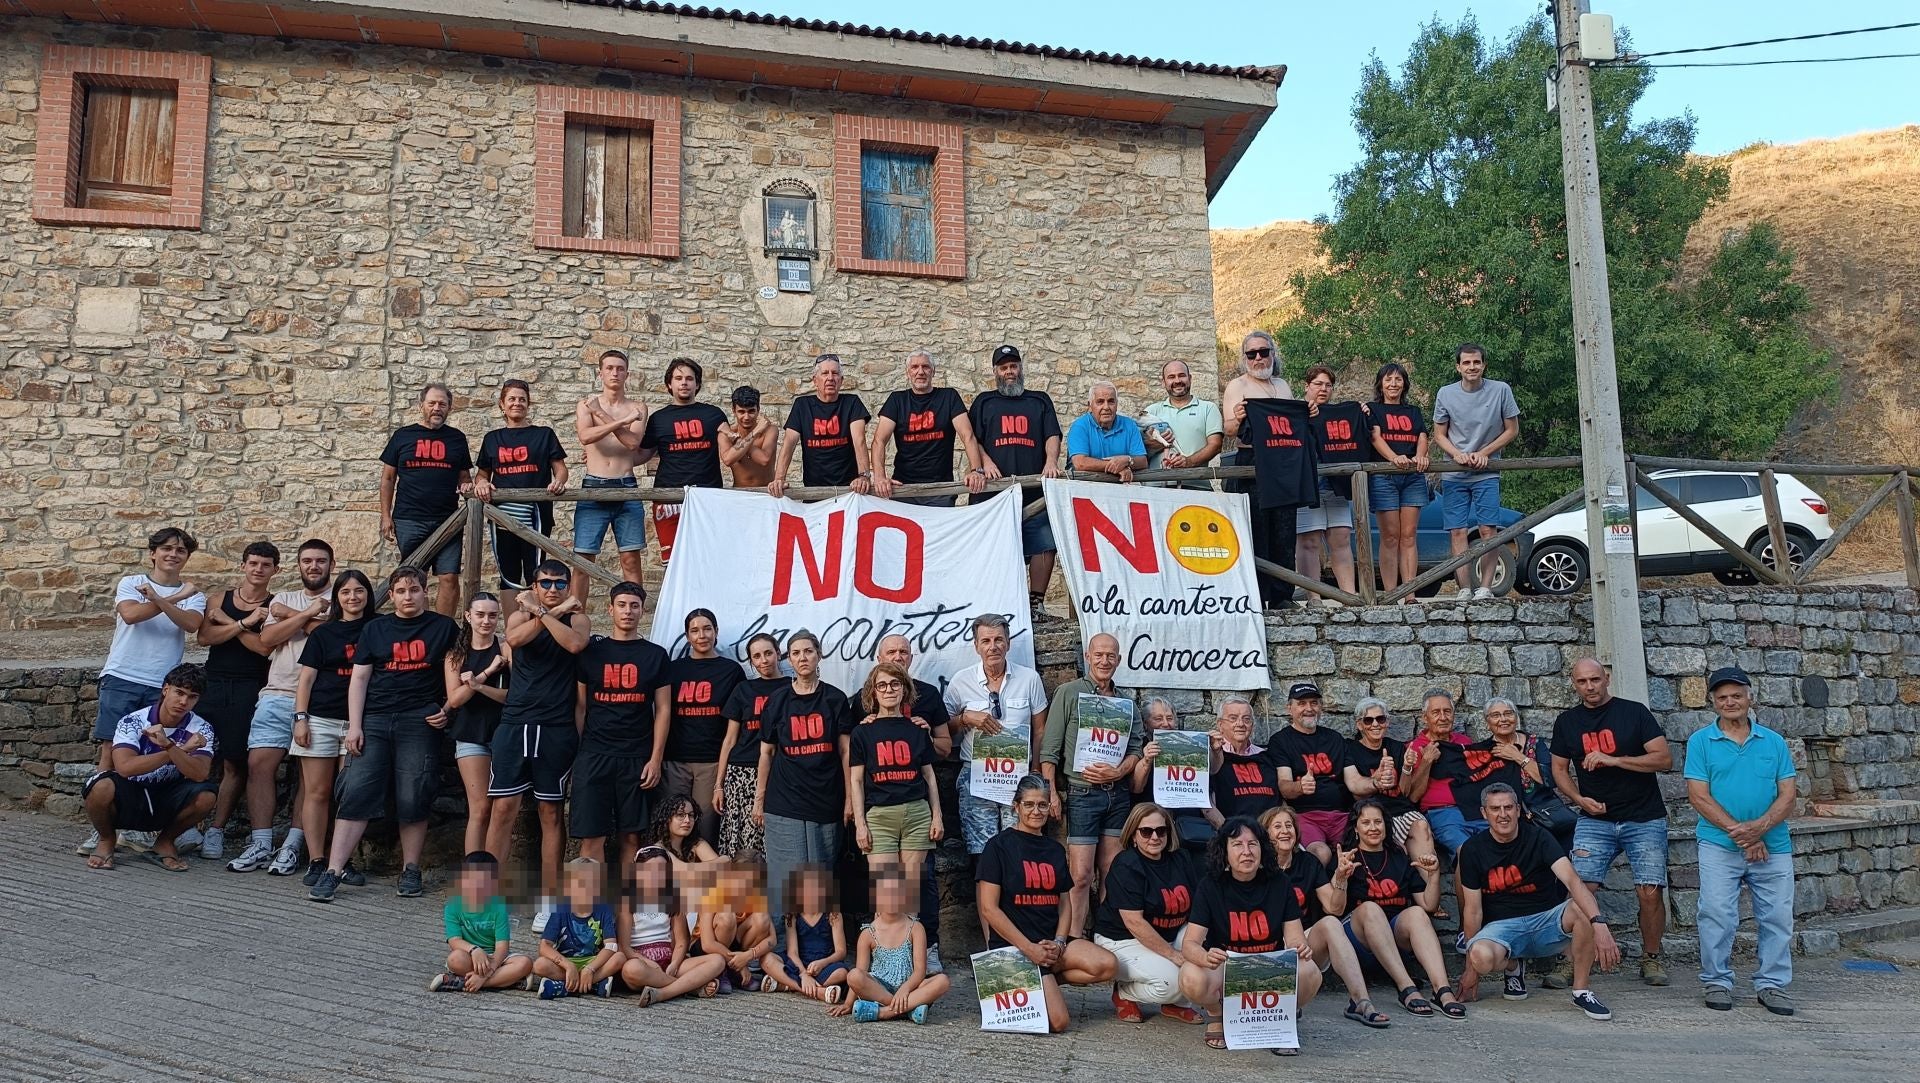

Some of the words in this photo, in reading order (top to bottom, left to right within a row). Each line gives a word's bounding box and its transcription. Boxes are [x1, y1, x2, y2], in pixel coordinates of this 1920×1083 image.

[779, 261, 808, 269] VIRGEN
[674, 420, 704, 439] NO
[814, 416, 840, 435] NO
[909, 410, 934, 432] NO
[1002, 416, 1028, 434] NO
[1267, 416, 1293, 435] NO
[1326, 420, 1352, 440] NO
[1386, 414, 1412, 431] NO
[415, 439, 446, 460] NO
[1009, 438, 1035, 446] CANTERA
[498, 446, 528, 463] NO
[1612, 526, 1630, 534] NO
[770, 510, 924, 606] NO
[1082, 594, 1098, 613] a
[1097, 584, 1130, 616] la
[1140, 583, 1264, 616] cantera
[394, 640, 426, 662] NO
[1128, 634, 1268, 672] Carrocera
[604, 664, 638, 689] NO
[600, 692, 609, 702] LA
[611, 694, 646, 703] CANTERA
[678, 682, 712, 703] NO
[685, 706, 720, 716] CANTERA
[754, 696, 768, 715] N
[790, 714, 824, 741] NO
[1092, 727, 1119, 745] NO
[791, 746, 799, 754] LA
[801, 744, 832, 754] CANTERA
[1098, 743, 1120, 752] cantera
[1582, 729, 1616, 754] NO
[876, 741, 911, 766] NO
[1088, 746, 1122, 758] CARROCERA
[985, 758, 1015, 774] NO
[1302, 752, 1332, 774] NO
[877, 774, 886, 782] LA
[888, 771, 918, 780] CANTER
[1168, 765, 1196, 782] NO
[1232, 762, 1263, 784] NO
[1166, 786, 1204, 794] CARROCERA
[1241, 788, 1249, 796] LA
[1022, 860, 1056, 890] NO
[1488, 864, 1522, 891] NO
[1366, 878, 1398, 898] NO
[1022, 894, 1032, 904] LA
[1161, 885, 1190, 914] NO
[1229, 910, 1270, 942] NO
[995, 988, 1028, 1011] NO
[1241, 991, 1280, 1010] NO
[996, 1012, 1041, 1024] CARROCERA
[1008, 1006, 1034, 1015] cantera
[1240, 1014, 1289, 1024] CARROCERA
